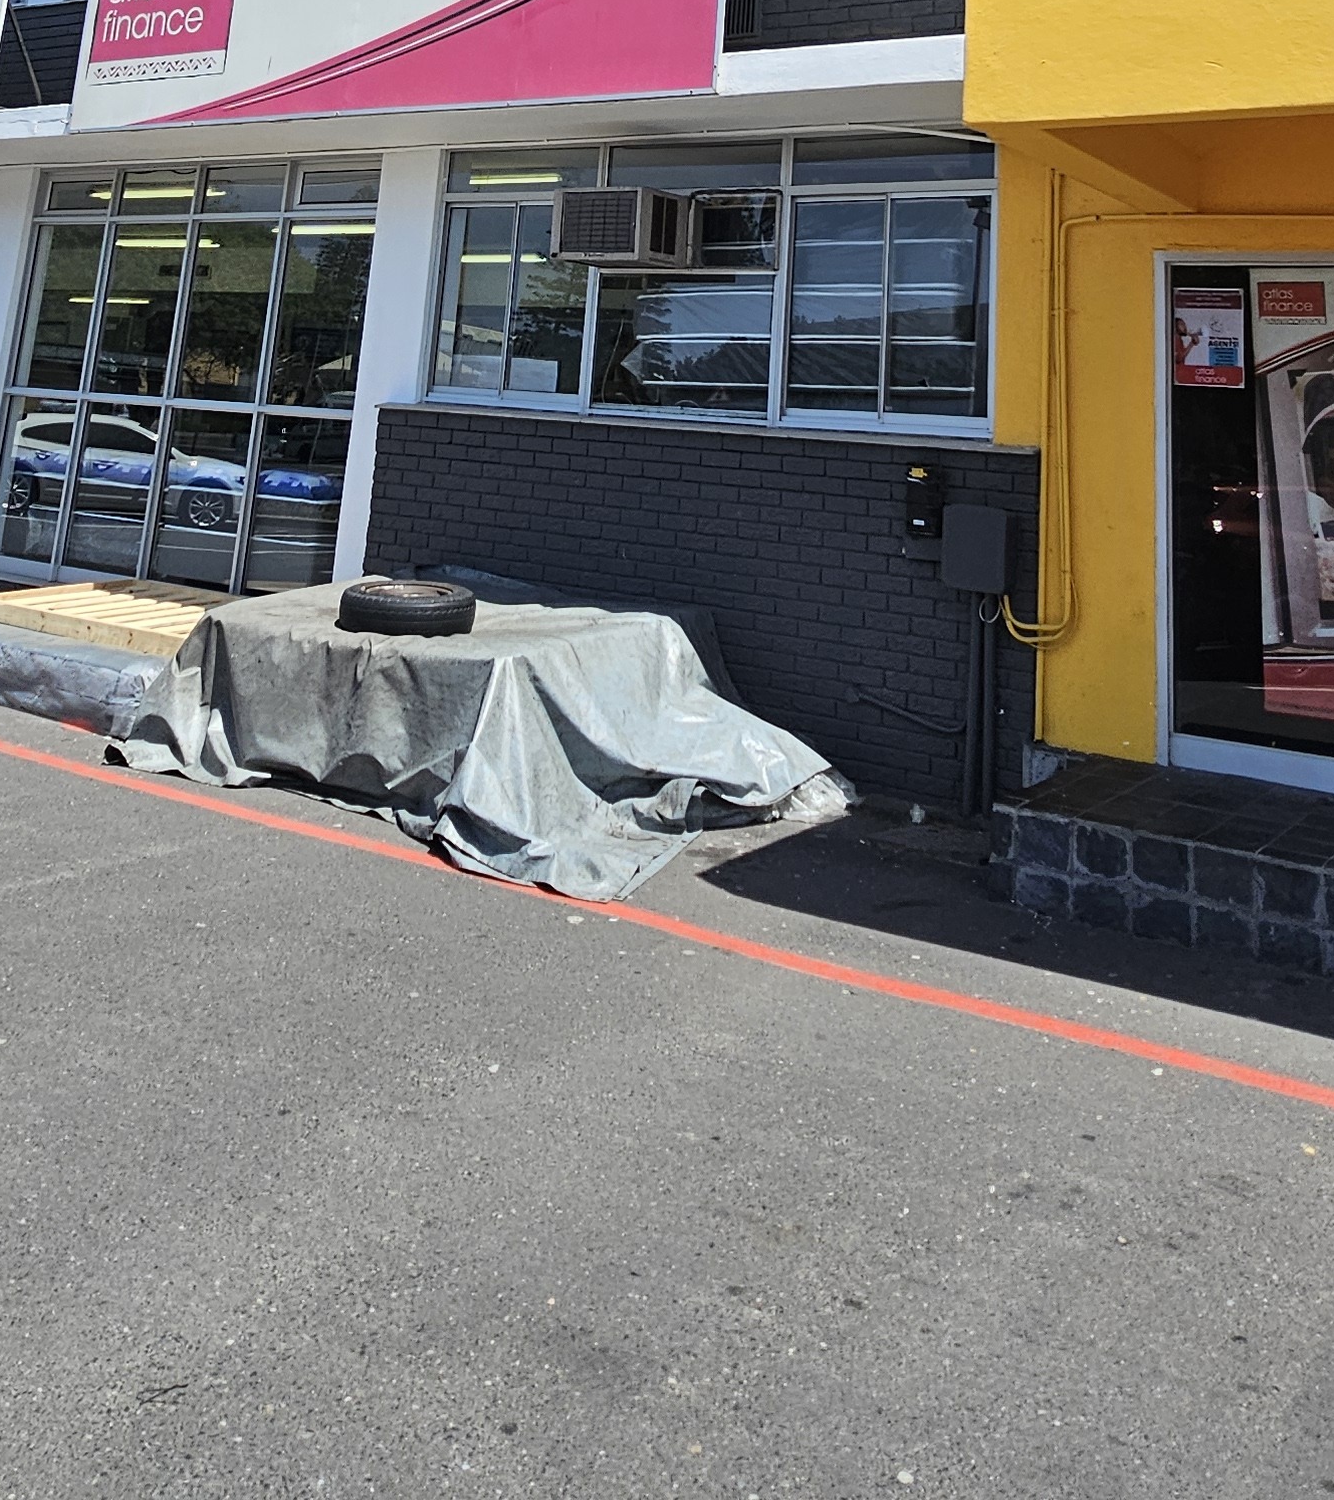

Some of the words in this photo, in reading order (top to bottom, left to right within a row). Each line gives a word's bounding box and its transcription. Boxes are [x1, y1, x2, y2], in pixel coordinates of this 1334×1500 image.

[102, 6, 204, 43] finance
[1262, 288, 1294, 300] atlas
[1263, 300, 1314, 312] finance
[1194, 375, 1227, 384] finance
